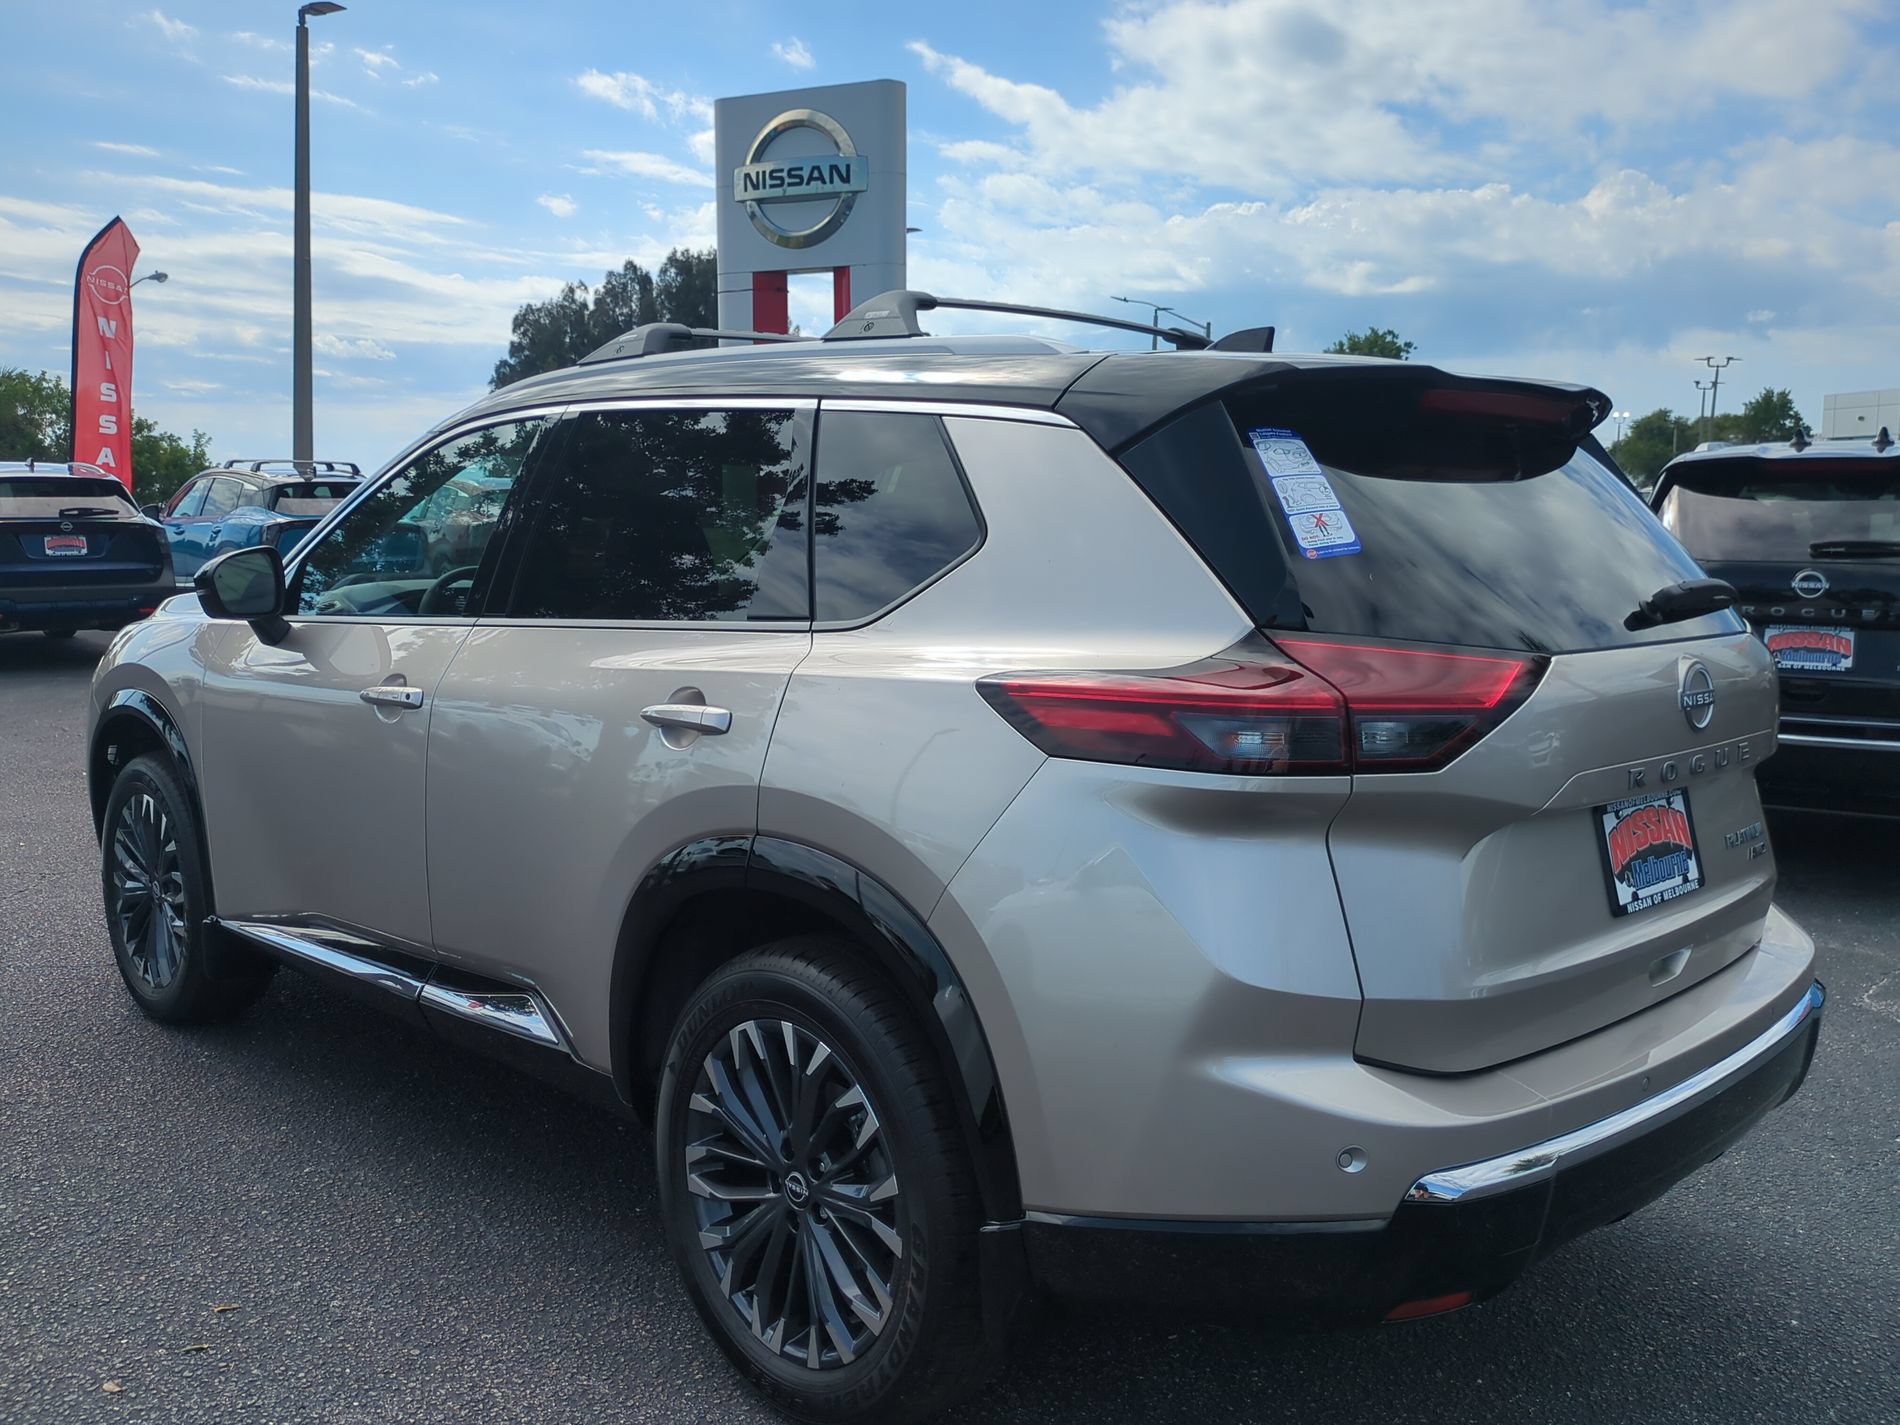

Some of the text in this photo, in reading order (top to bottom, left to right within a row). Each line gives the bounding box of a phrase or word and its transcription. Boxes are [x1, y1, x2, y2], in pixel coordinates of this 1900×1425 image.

[743, 163, 851, 193] NISSAN
[1741, 605, 1877, 620] ROGUE
[1768, 631, 1852, 657] NISSAN
[1628, 742, 1752, 790] ROGUE
[1609, 804, 1693, 874] NISSAN
[1632, 850, 1689, 889] Melbourne
[1627, 880, 1700, 914] NISSAN OF MELBOURNE
